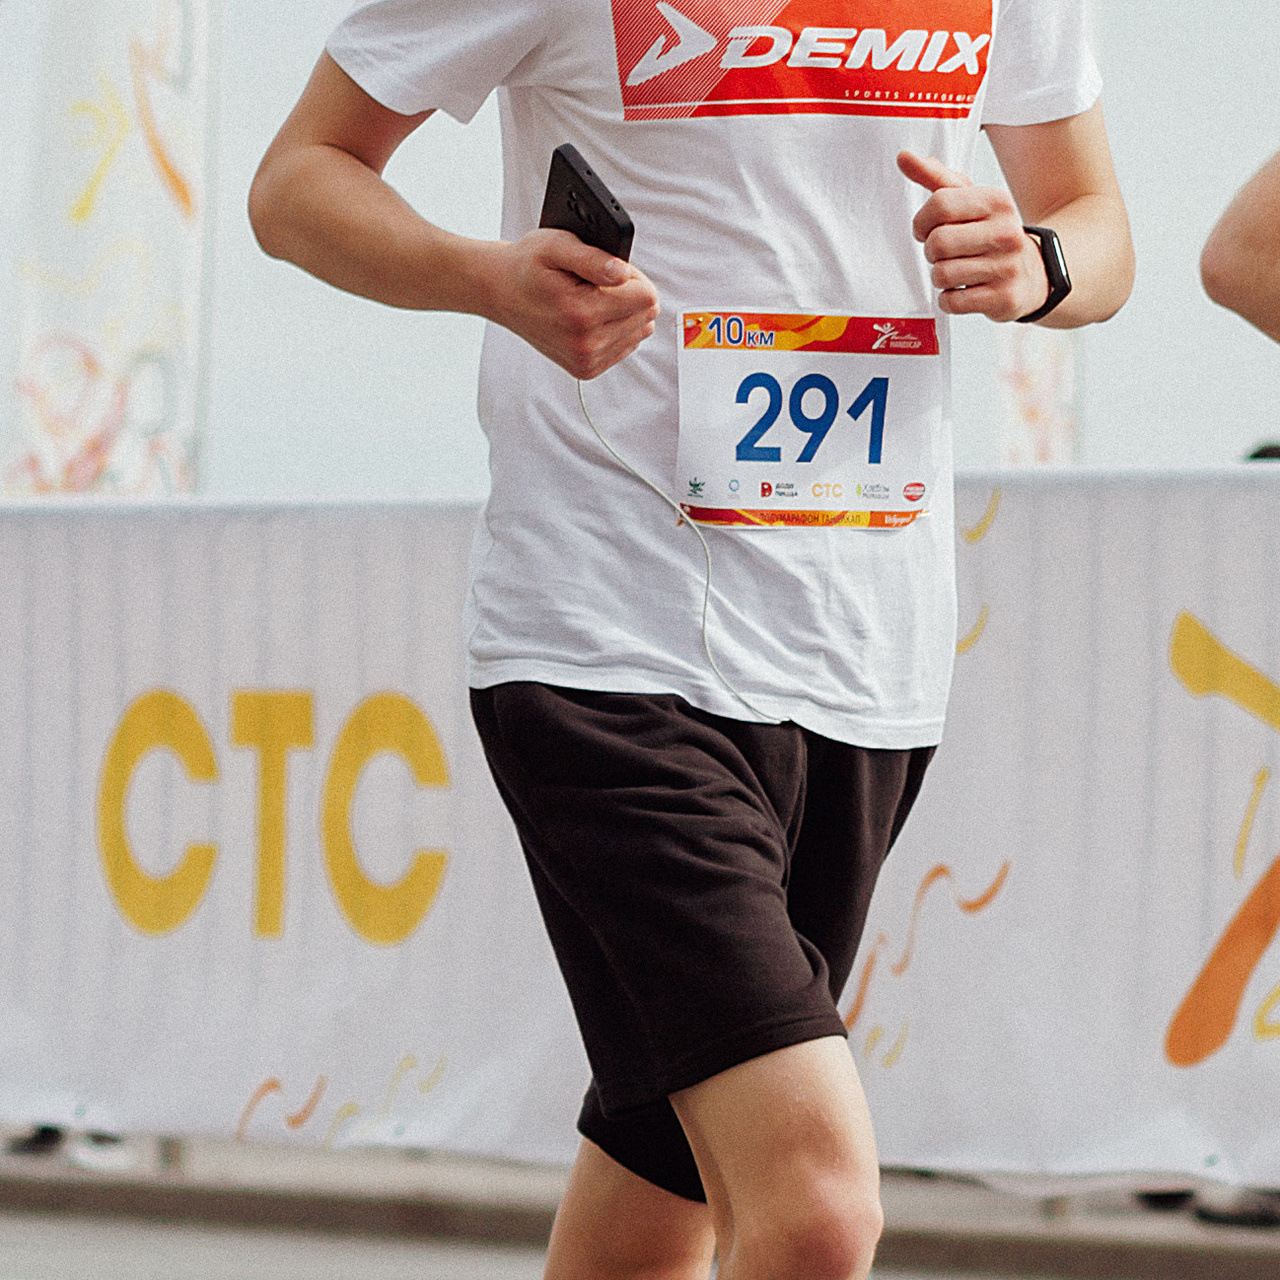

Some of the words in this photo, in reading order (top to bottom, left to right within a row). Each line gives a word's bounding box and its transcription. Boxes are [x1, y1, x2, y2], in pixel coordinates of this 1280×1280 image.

[719, 25, 990, 75] DEMIX
[844, 89, 899, 100] SPORTS
[707, 316, 744, 346] 10
[735, 372, 889, 465] 291
